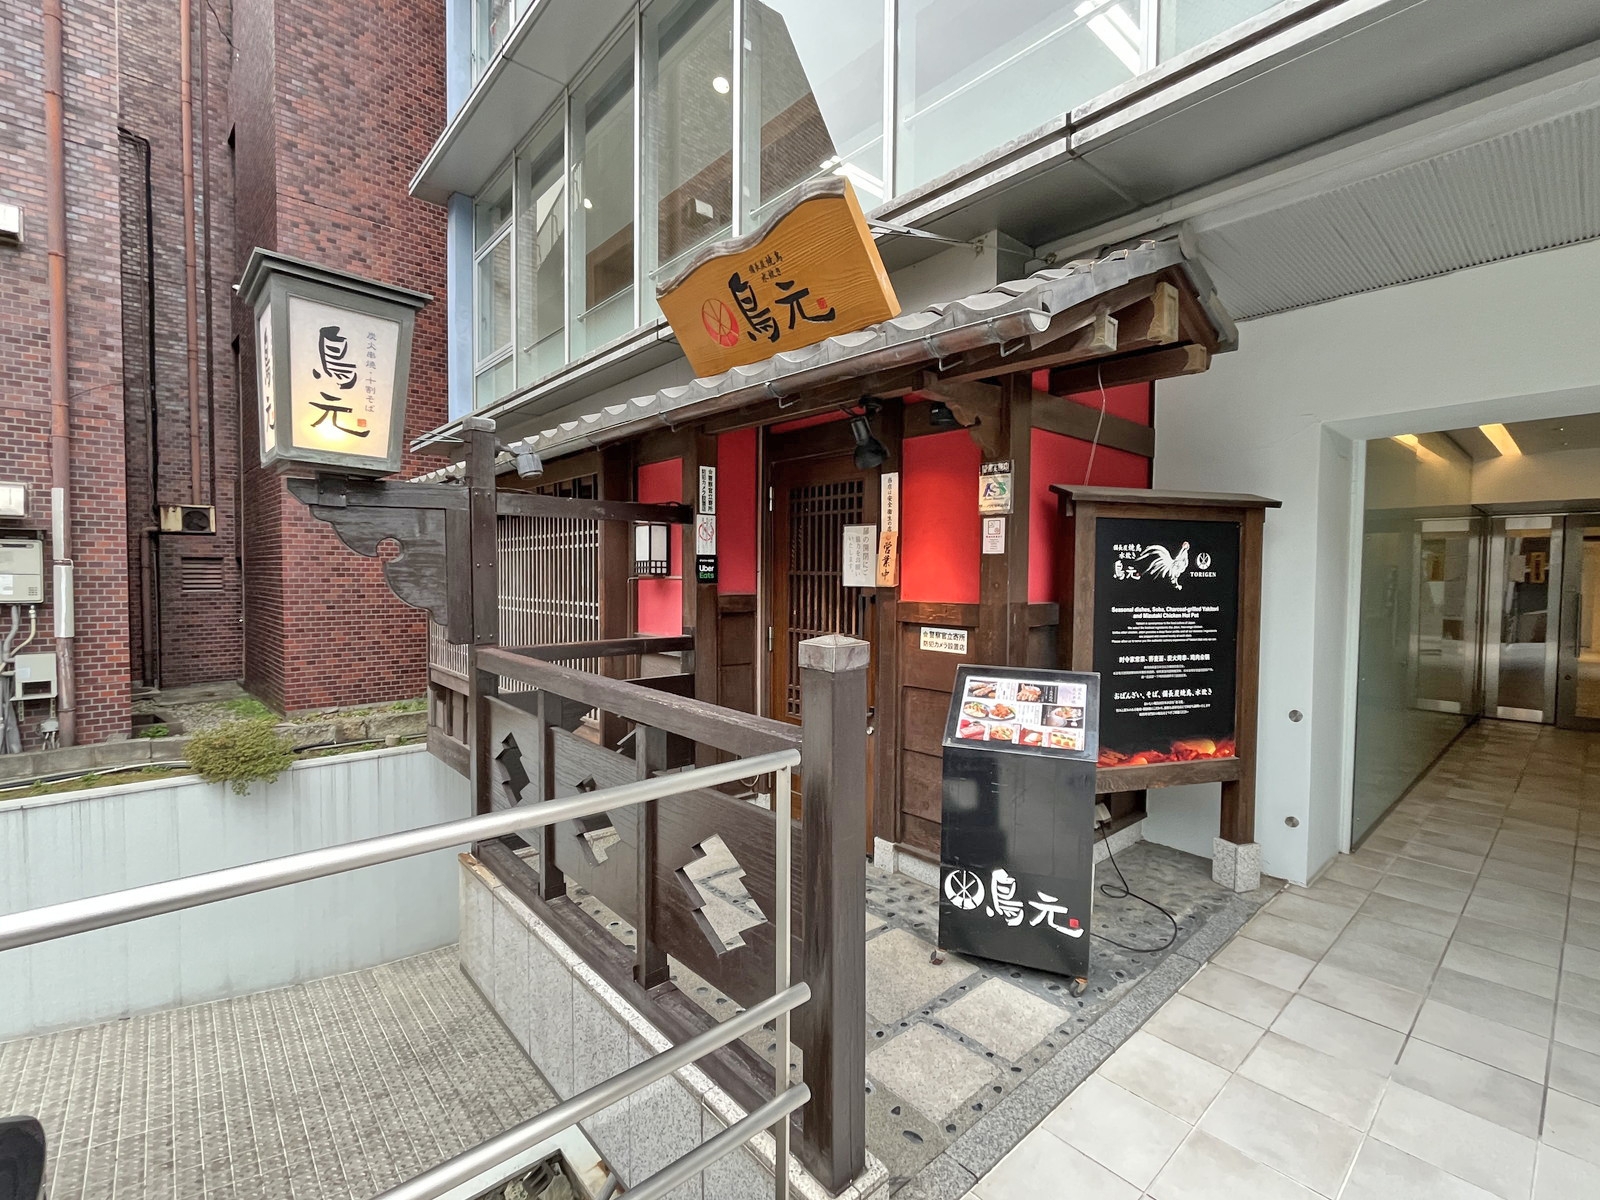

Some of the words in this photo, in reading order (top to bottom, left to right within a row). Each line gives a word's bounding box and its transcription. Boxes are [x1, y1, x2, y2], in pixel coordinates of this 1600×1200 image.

[761, 267, 782, 283] 水炊き
[728, 271, 836, 343] 鳥元
[308, 325, 371, 438] 鳥元
[1118, 551, 1137, 560] 水炊き
[699, 564, 715, 572] Uber
[1112, 560, 1142, 581] 鳥元
[923, 640, 965, 652] 防犯カメラ設置店
[986, 869, 1084, 939] 鳥元
